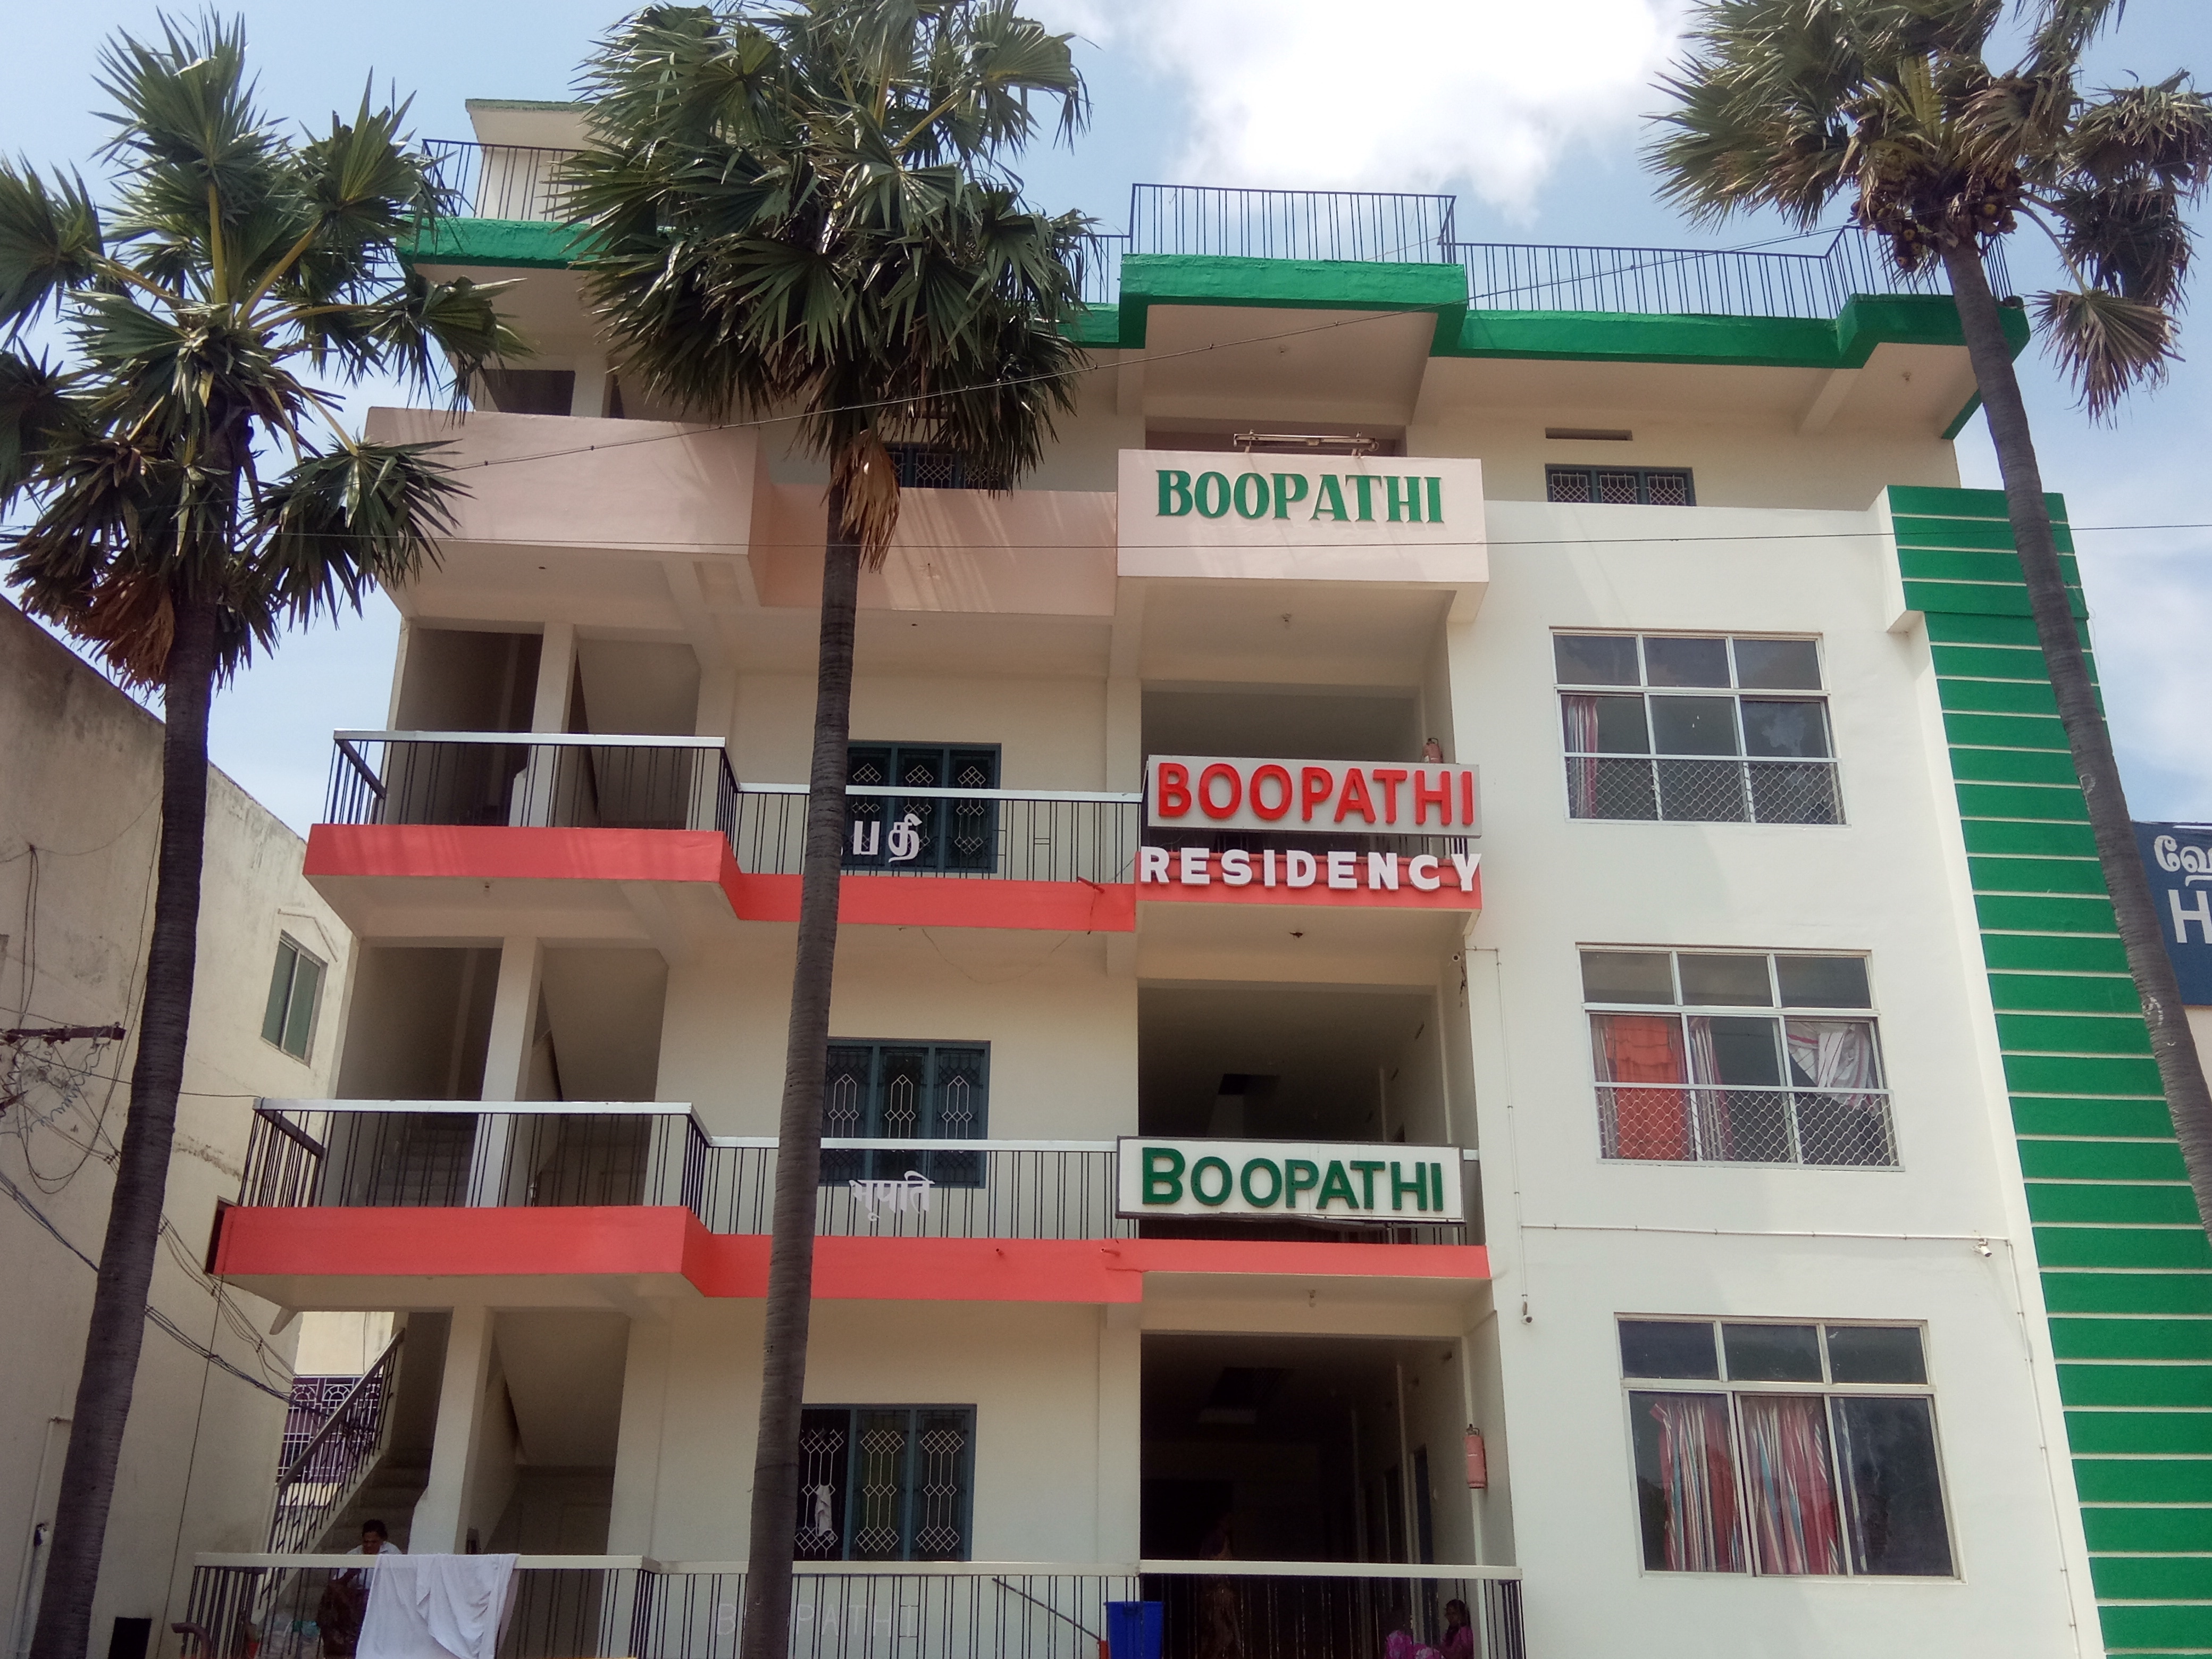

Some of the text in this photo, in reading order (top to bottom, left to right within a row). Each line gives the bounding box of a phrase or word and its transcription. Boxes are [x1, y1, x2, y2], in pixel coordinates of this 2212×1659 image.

[1155, 470, 1444, 523] BOOPATHI
[1158, 762, 1474, 825] BOOPATHI
[840, 813, 923, 863] பதி
[1141, 846, 1481, 892] RESIDENCY
[1142, 1147, 1444, 1212] BOOPATHI
[716, 1603, 912, 1638] BPATHI
